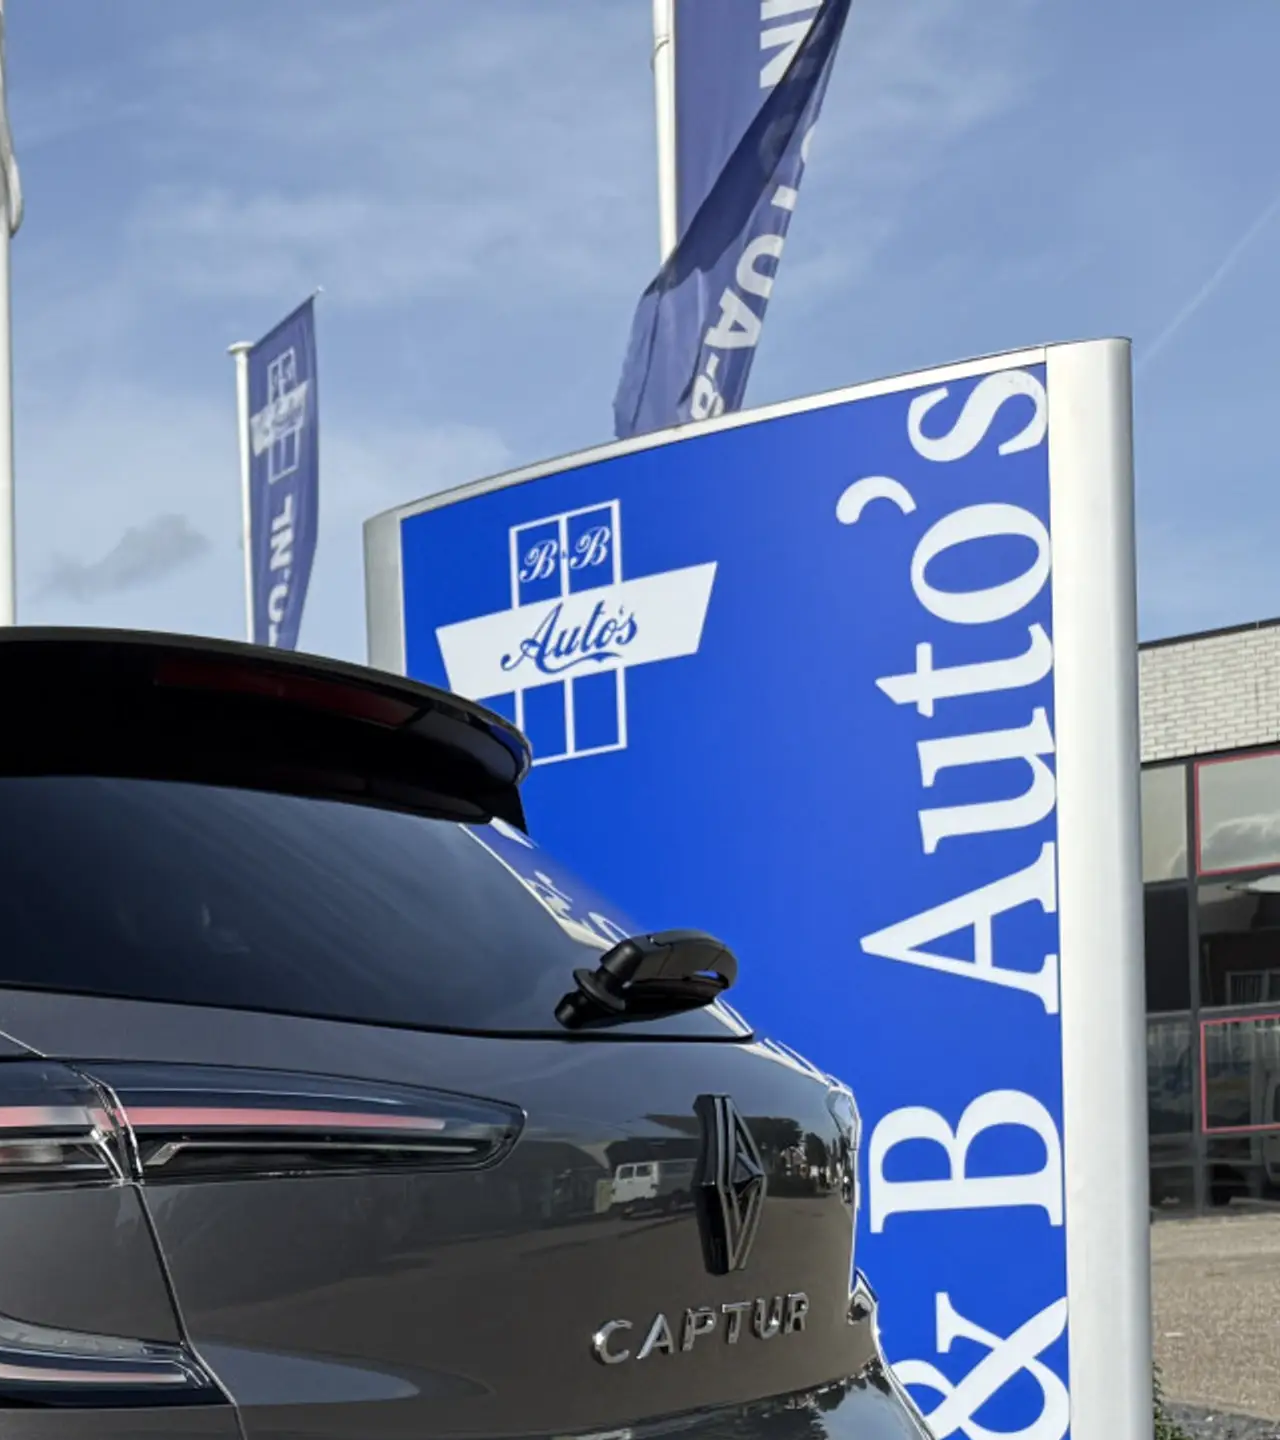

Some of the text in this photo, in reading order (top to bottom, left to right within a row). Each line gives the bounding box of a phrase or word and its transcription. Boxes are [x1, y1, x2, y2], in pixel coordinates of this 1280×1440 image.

[500, 599, 638, 674] Auto's
[836, 369, 1059, 1015] Auto's
[868, 1088, 1063, 1233] B
[591, 1292, 810, 1365] CAPTUR
